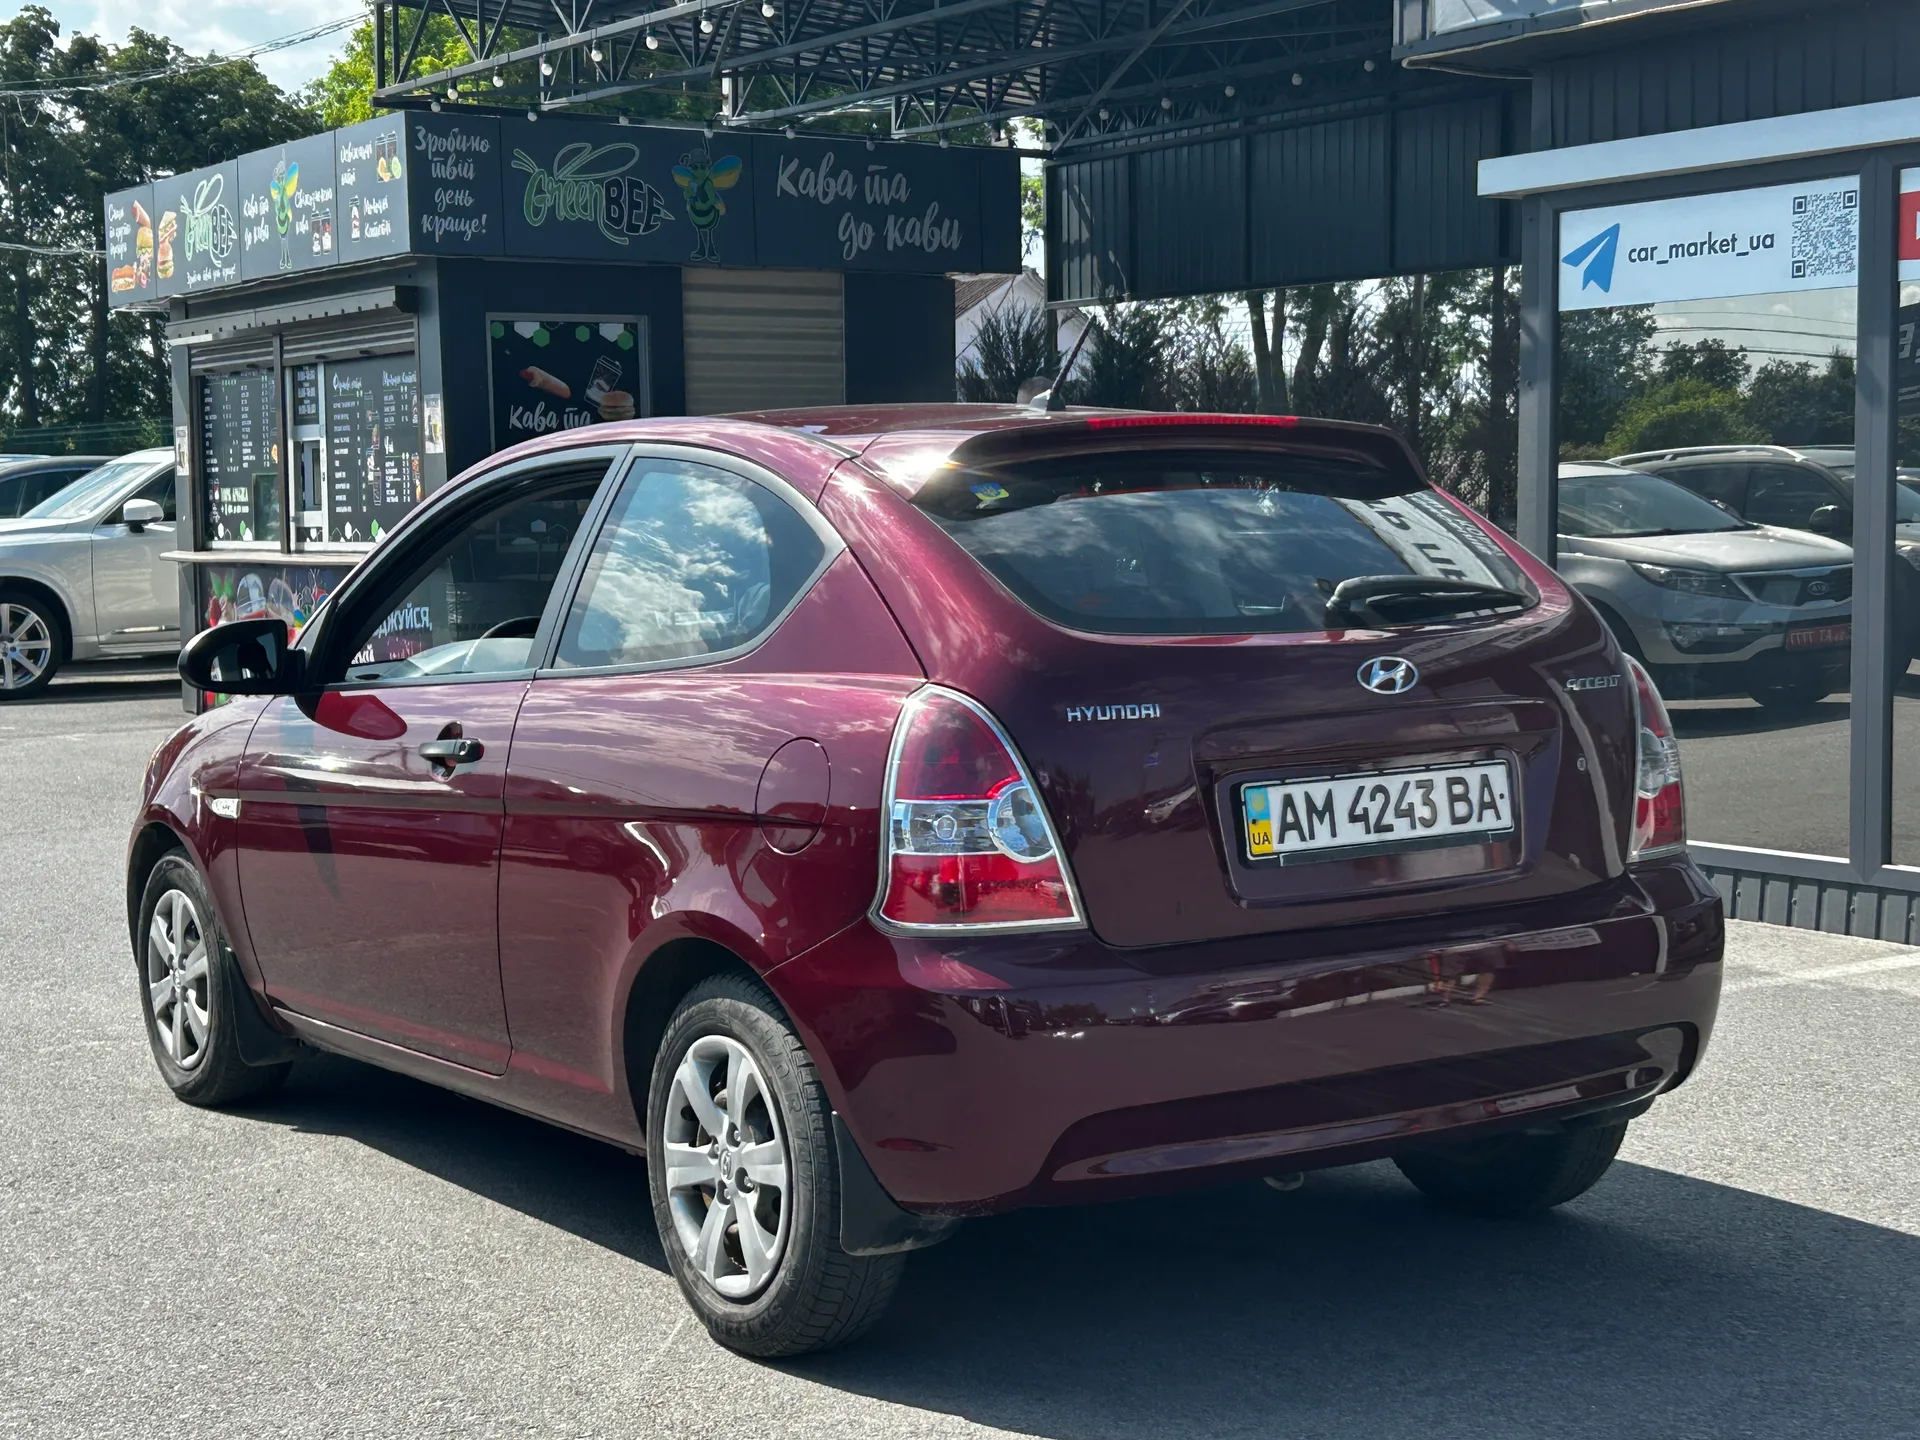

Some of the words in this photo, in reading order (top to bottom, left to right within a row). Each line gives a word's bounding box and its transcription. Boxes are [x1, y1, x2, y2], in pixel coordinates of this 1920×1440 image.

[414, 126, 490, 160] Зробимо
[431, 153, 475, 181] твій
[777, 152, 858, 204] Кава
[864, 164, 911, 205] та
[434, 187, 475, 212] день
[421, 214, 487, 243] краще!
[838, 211, 875, 260] до
[884, 201, 962, 252] кави
[1628, 231, 1775, 265] car_market_ua
[509, 401, 559, 432] Кава
[564, 407, 593, 430] та
[1066, 703, 1160, 722] HYUNDAI
[1277, 788, 1337, 844] AM
[1348, 778, 1437, 835] 4243
[1445, 773, 1502, 825] BA
[1252, 831, 1271, 845] UA
